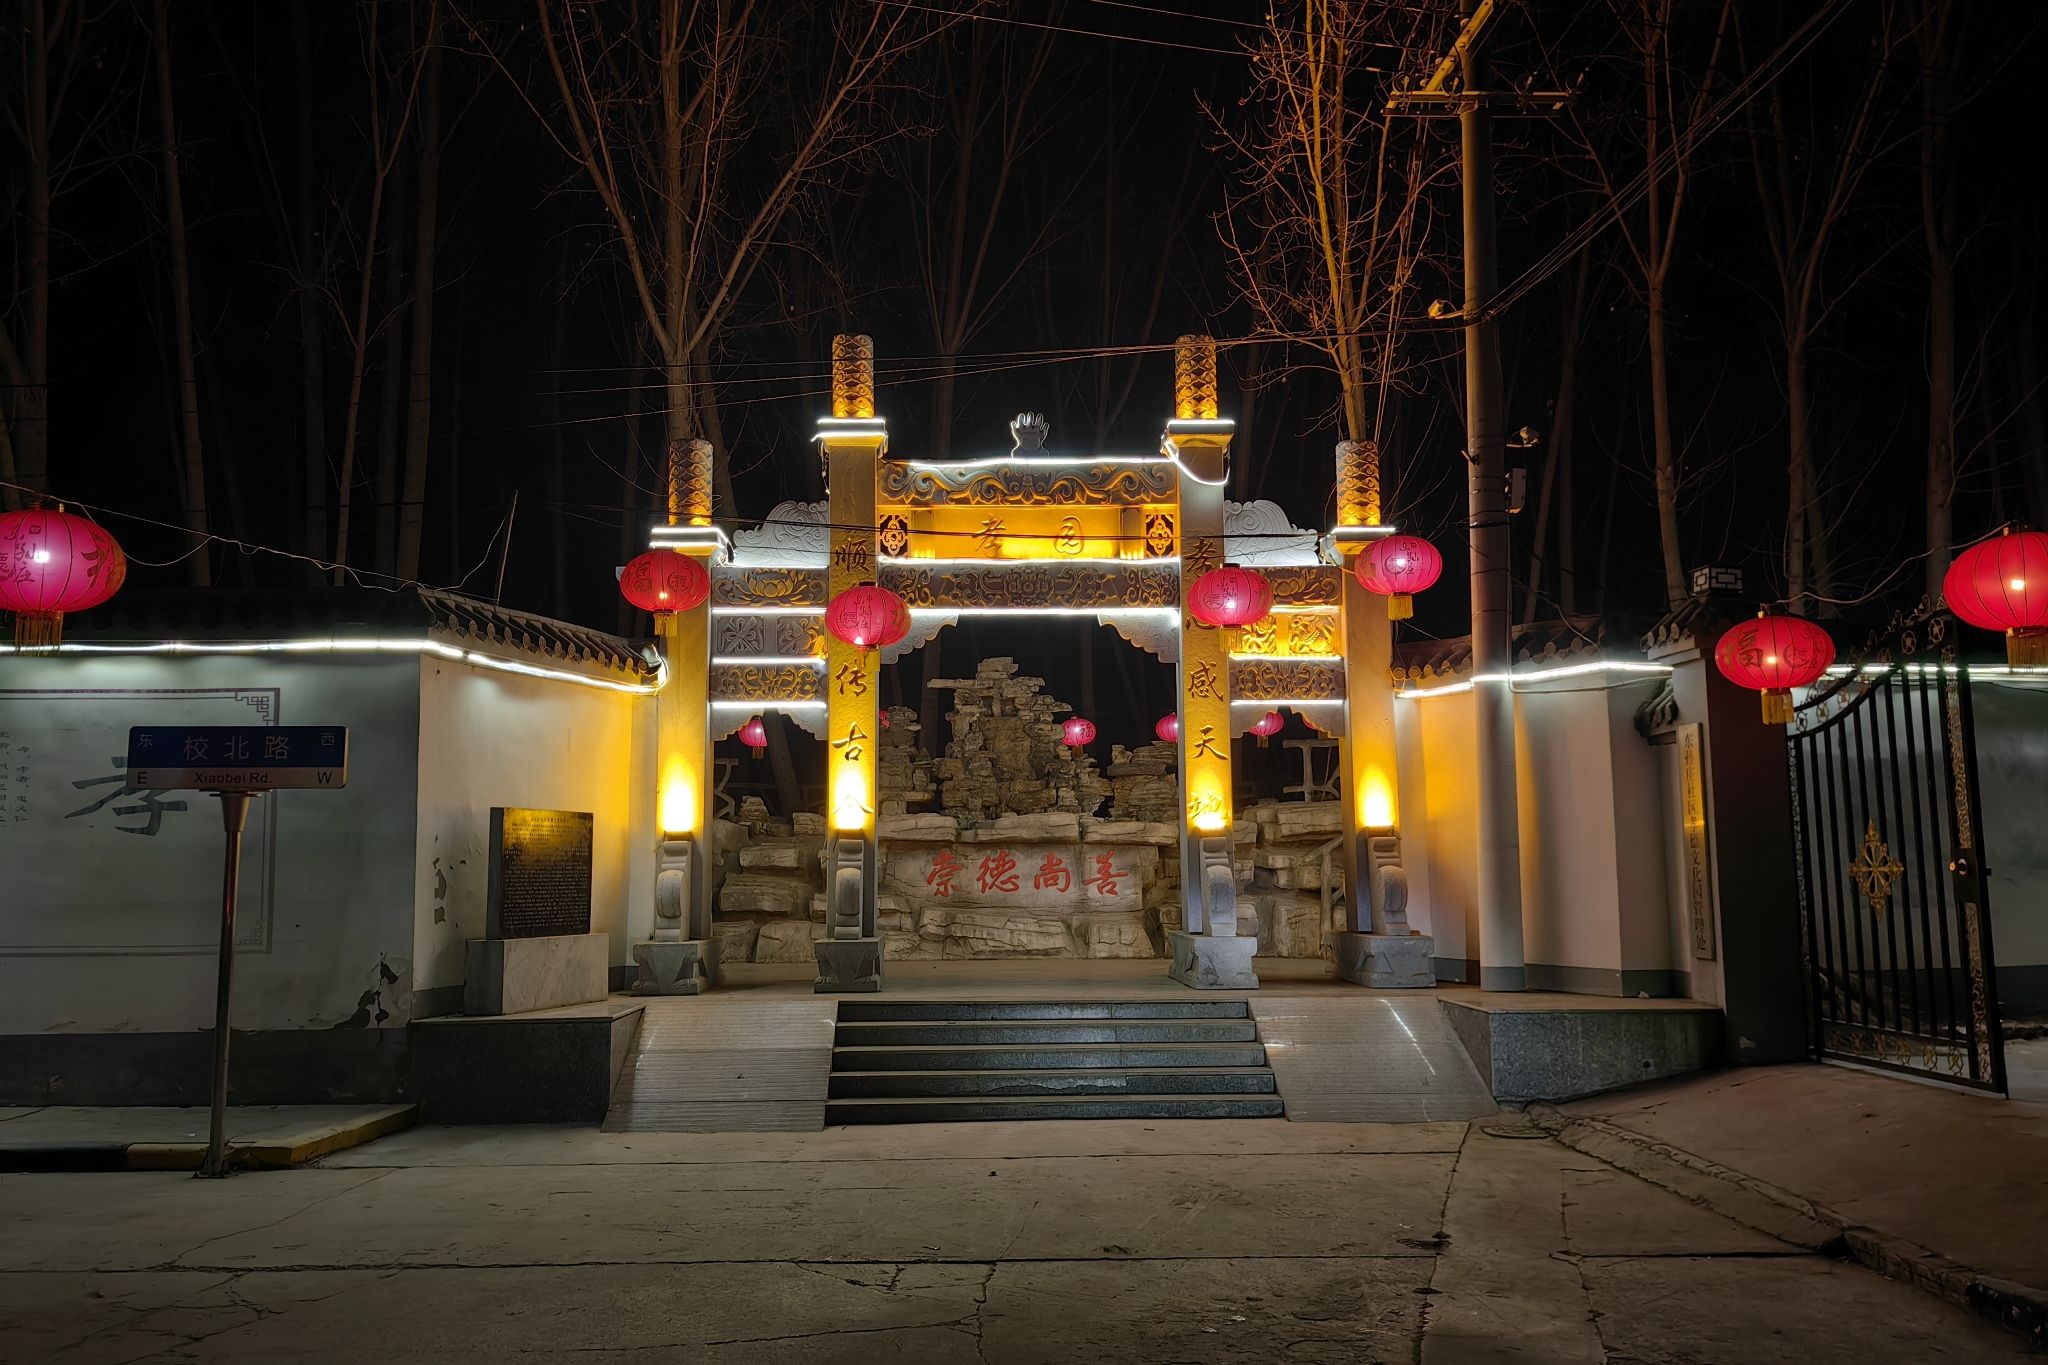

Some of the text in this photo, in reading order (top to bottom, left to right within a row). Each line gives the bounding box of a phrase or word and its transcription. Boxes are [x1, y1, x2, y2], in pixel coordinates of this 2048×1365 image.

[137, 732, 335, 760] 东 校北路 西
[137, 771, 149, 785] E
[194, 771, 246, 784] Xiaobei
[317, 771, 333, 785] W
[926, 849, 1130, 897] 崇德尚善
